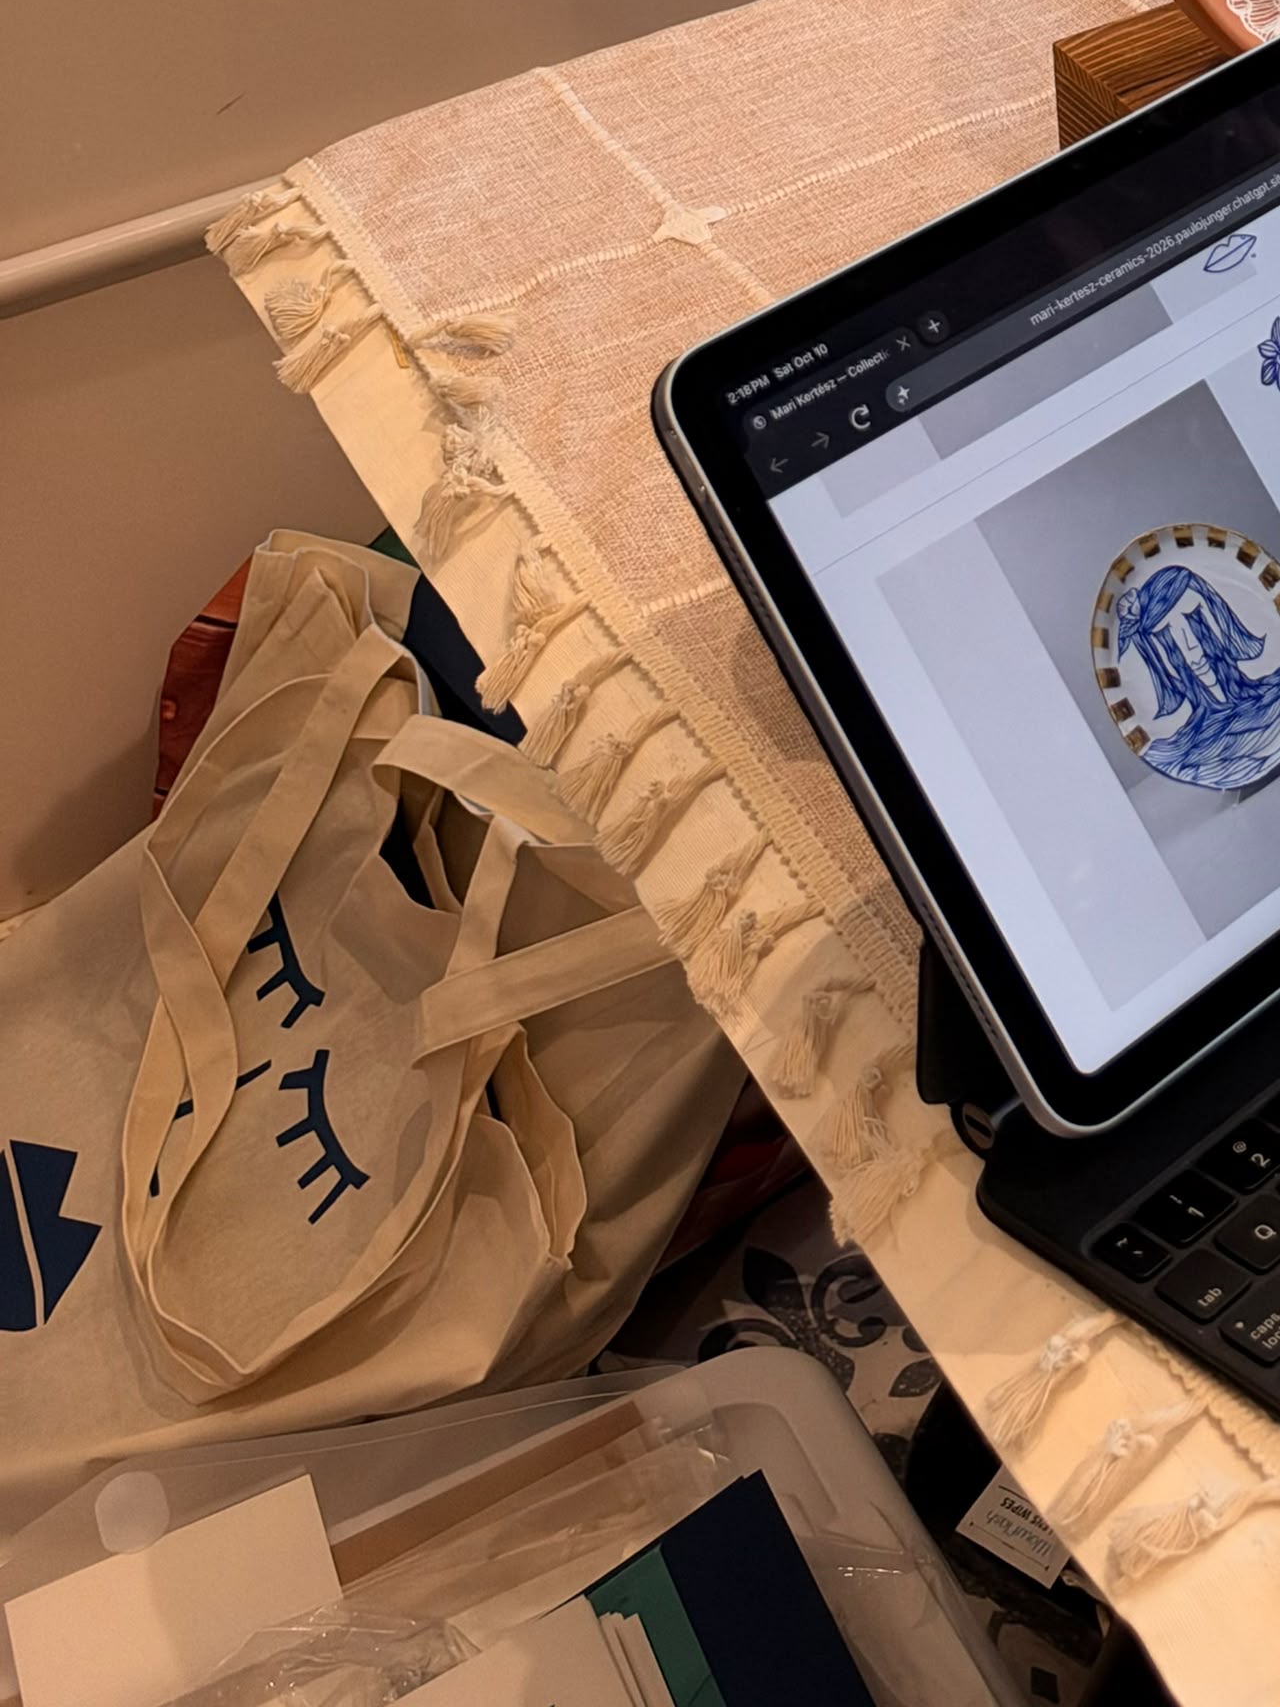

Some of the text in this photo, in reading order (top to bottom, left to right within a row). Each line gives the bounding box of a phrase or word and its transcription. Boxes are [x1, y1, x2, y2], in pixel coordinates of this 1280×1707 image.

[773, 364, 794, 380] Sat
[793, 352, 815, 368] Oct
[814, 343, 829, 360] 10
[769, 401, 797, 421] Mari
[797, 379, 837, 409] Kertész
[1233, 1142, 1246, 1153] @
[1251, 1154, 1270, 1167] 2
[1255, 1225, 1276, 1239] Q
[1198, 1288, 1221, 1306] tab
[1000, 1497, 1032, 1521] WIPES
